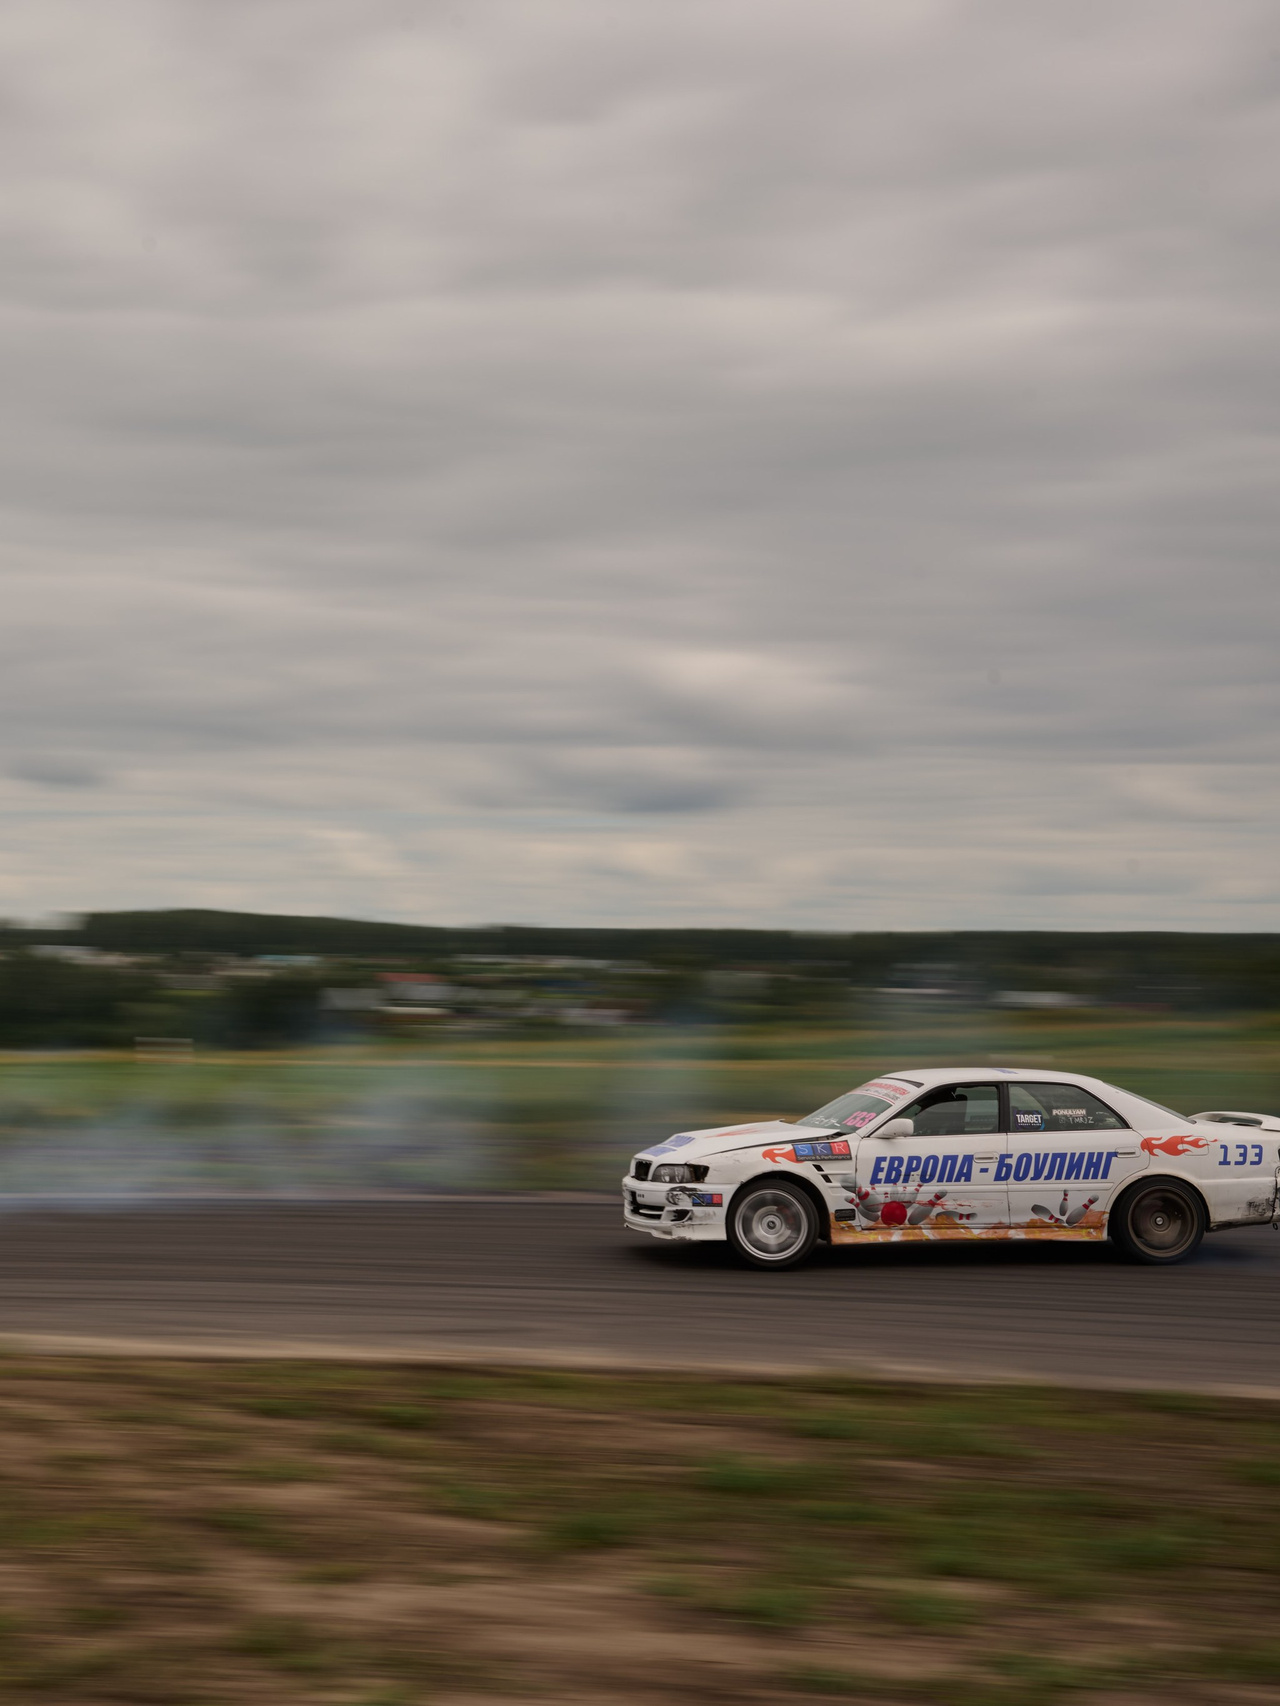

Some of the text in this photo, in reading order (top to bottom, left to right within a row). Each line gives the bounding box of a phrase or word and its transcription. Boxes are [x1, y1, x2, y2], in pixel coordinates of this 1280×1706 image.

[842, 1111, 876, 1127] 133
[1016, 1114, 1042, 1124] TARGET
[1218, 1144, 1263, 1166] 133
[870, 1154, 975, 1185] ЕВРОПА
[994, 1151, 1117, 1182] БОУЛИНГ
